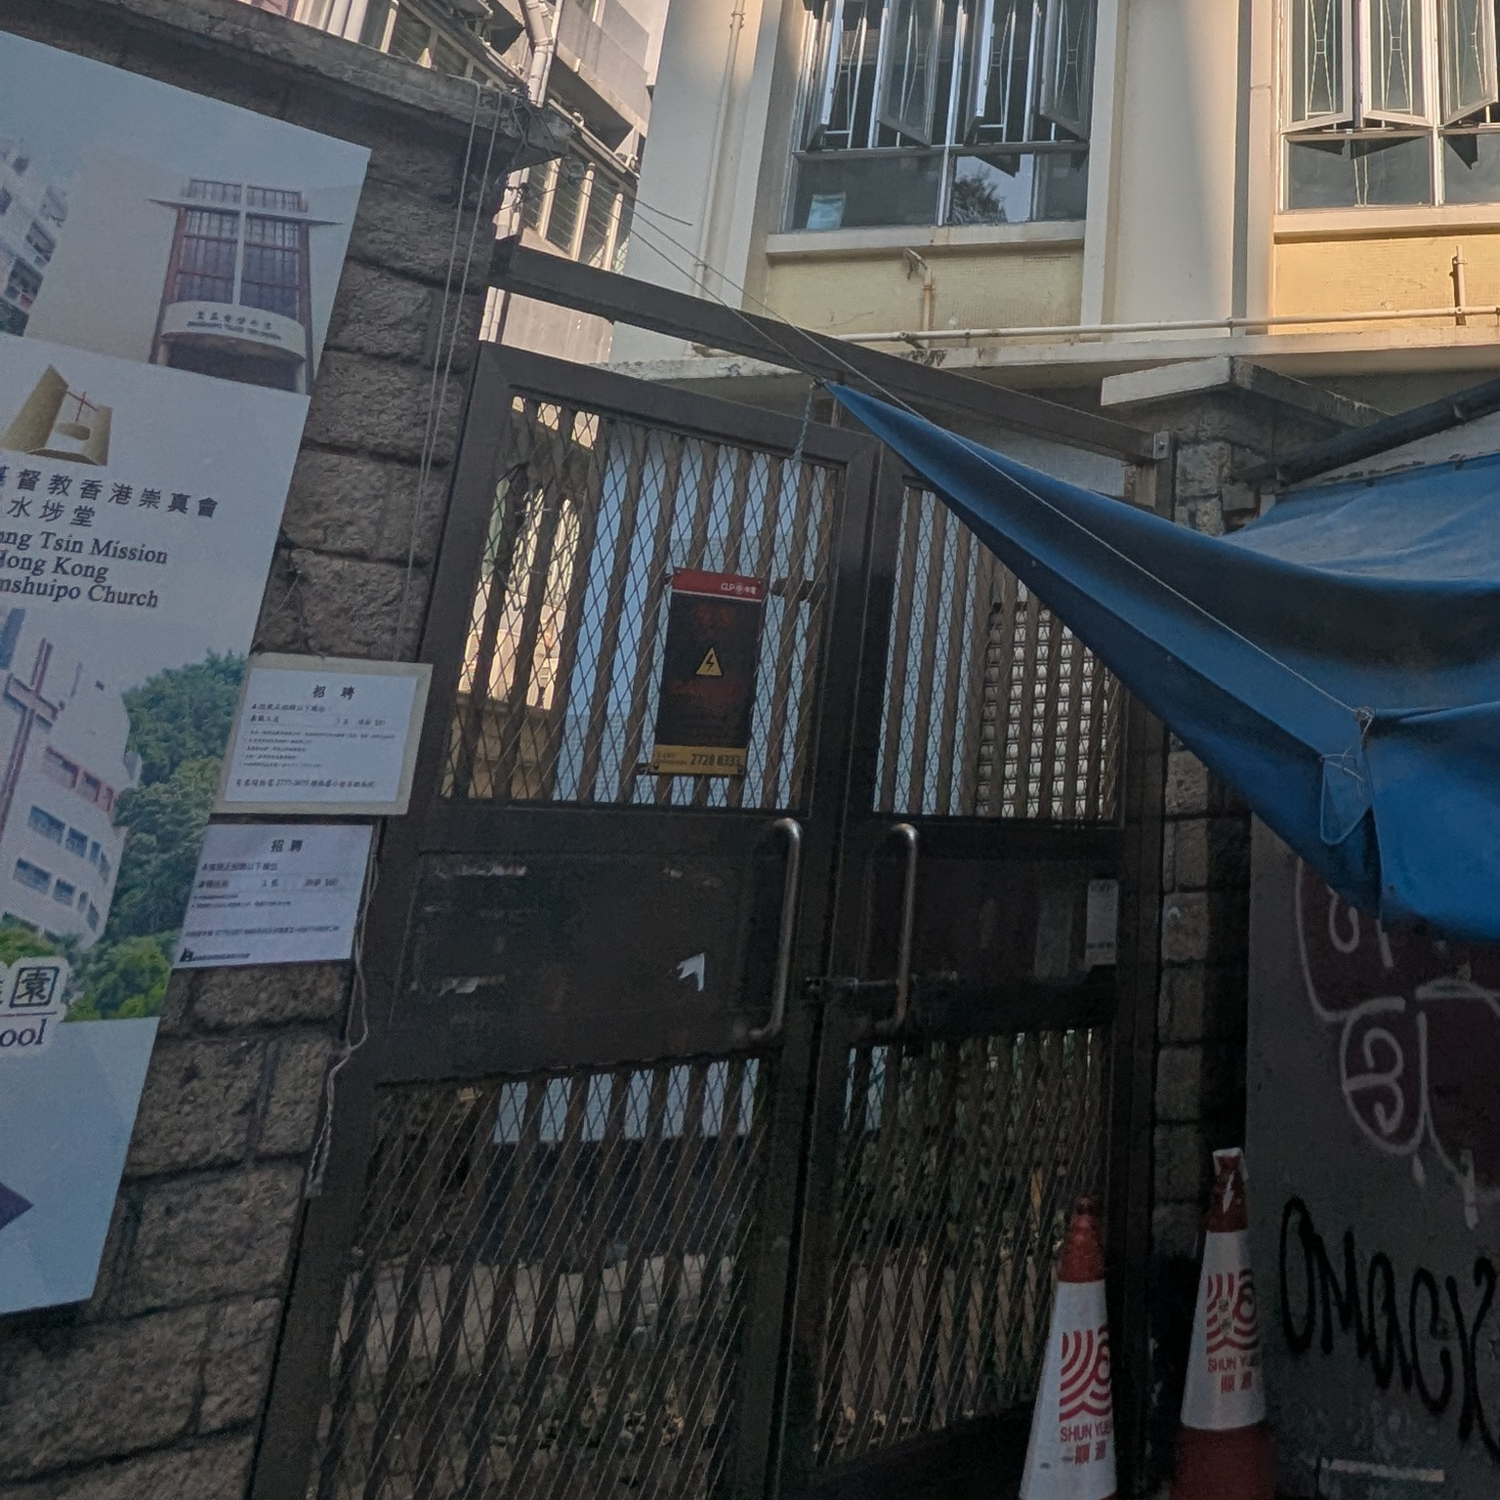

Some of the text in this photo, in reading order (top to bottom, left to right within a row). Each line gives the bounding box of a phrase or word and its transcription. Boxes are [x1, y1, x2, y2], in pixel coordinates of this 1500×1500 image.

[41, 531, 83, 554] Tsin
[89, 538, 168, 565] Mission
[52, 556, 109, 584] Kong
[88, 584, 158, 609] Church
[720, 582, 735, 592] CLP
[0, 966, 60, 1009] 園
[1060, 1423, 1092, 1443] SHUN
